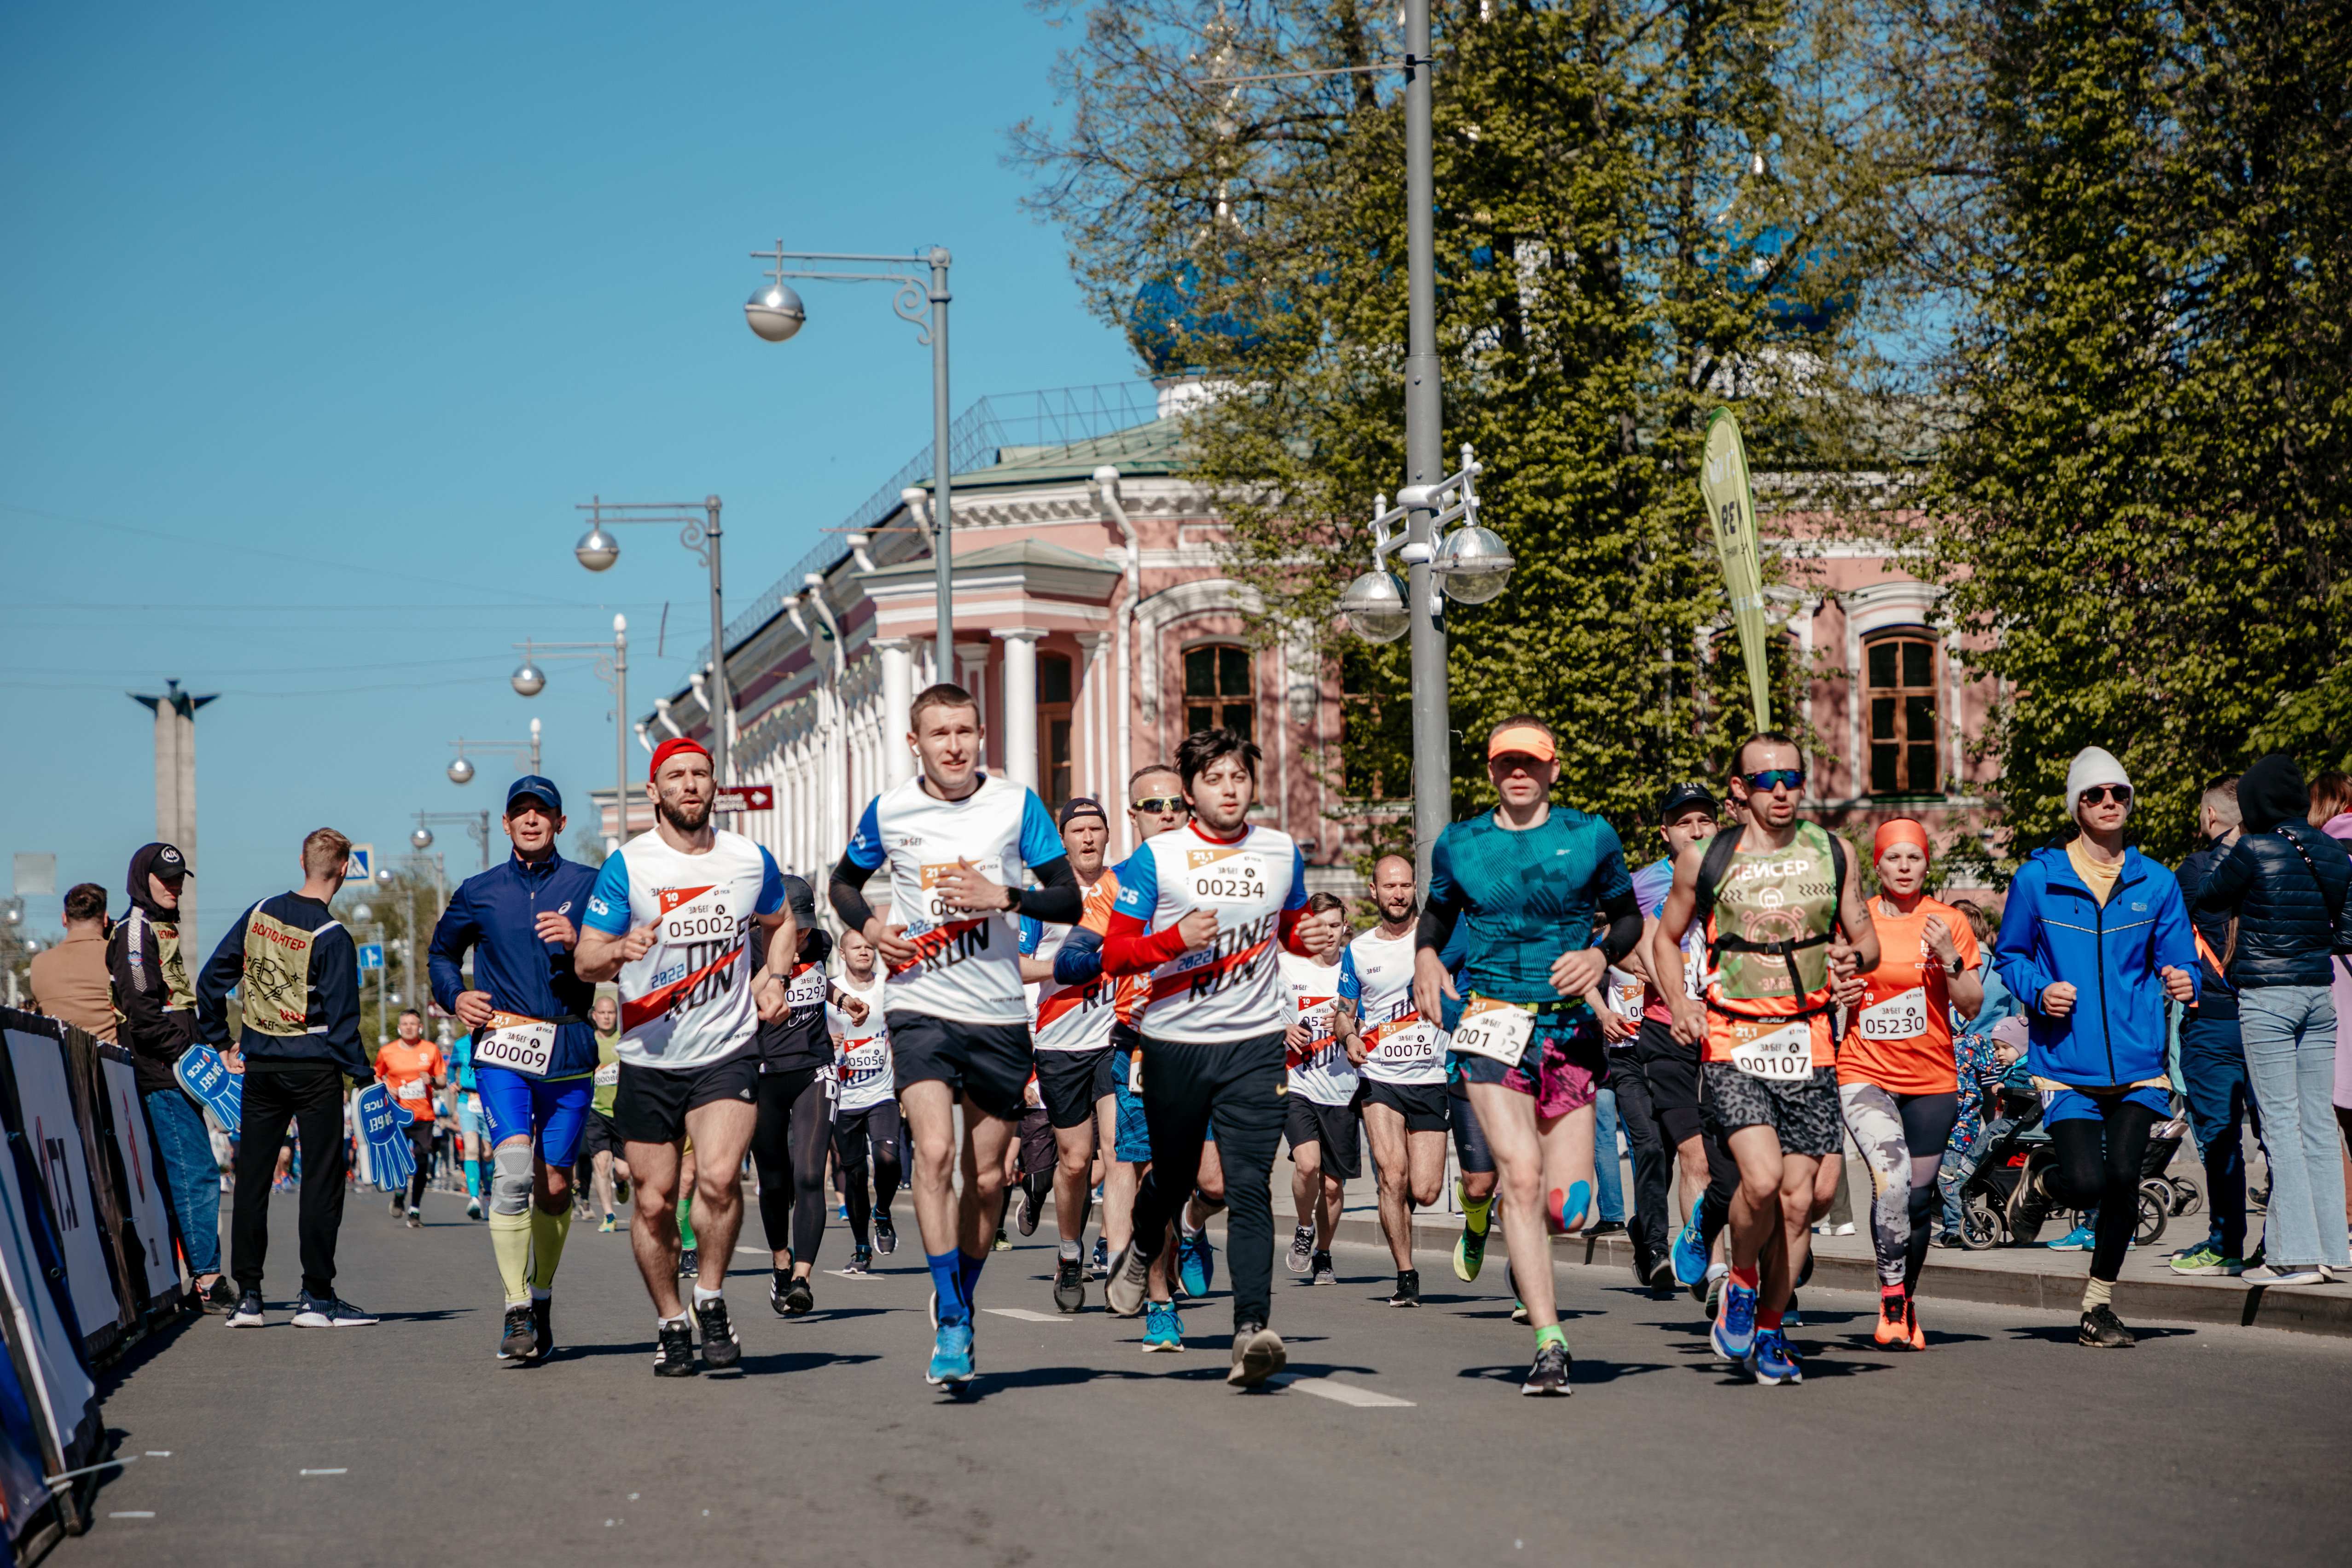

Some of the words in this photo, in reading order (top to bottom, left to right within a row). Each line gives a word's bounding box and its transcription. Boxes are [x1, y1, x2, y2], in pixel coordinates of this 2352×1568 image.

[909, 837, 922, 846] БЕГ
[1193, 851, 1214, 861] 21,1
[665, 892, 679, 902] 10
[1196, 879, 1265, 898] 00234
[698, 905, 709, 913] БЕГ
[669, 916, 734, 937] 05002
[251, 922, 307, 952] ВОЛОНТЕР
[923, 917, 989, 973] RUN
[1213, 910, 1279, 964] ONE
[1177, 950, 1212, 972] 2022
[651, 963, 685, 989] 2022
[1187, 954, 1260, 1004] RUN
[1778, 975, 1794, 990] БЕ
[786, 984, 825, 1003] 05292
[1082, 975, 1116, 1015] RU
[1864, 993, 1874, 1001] 10
[493, 1015, 510, 1026] 21,1
[1382, 1025, 1396, 1033] 21,1
[1866, 1016, 1924, 1034] 05230
[507, 1032, 515, 1040] ЗА
[517, 1034, 527, 1043] БЕГ
[1736, 1027, 1757, 1039] 21,1
[1384, 1043, 1432, 1057] 00076
[1457, 1028, 1520, 1057] 0012
[484, 1041, 546, 1068] 00009
[849, 1055, 884, 1067] 05056
[1741, 1057, 1808, 1074] 00107
